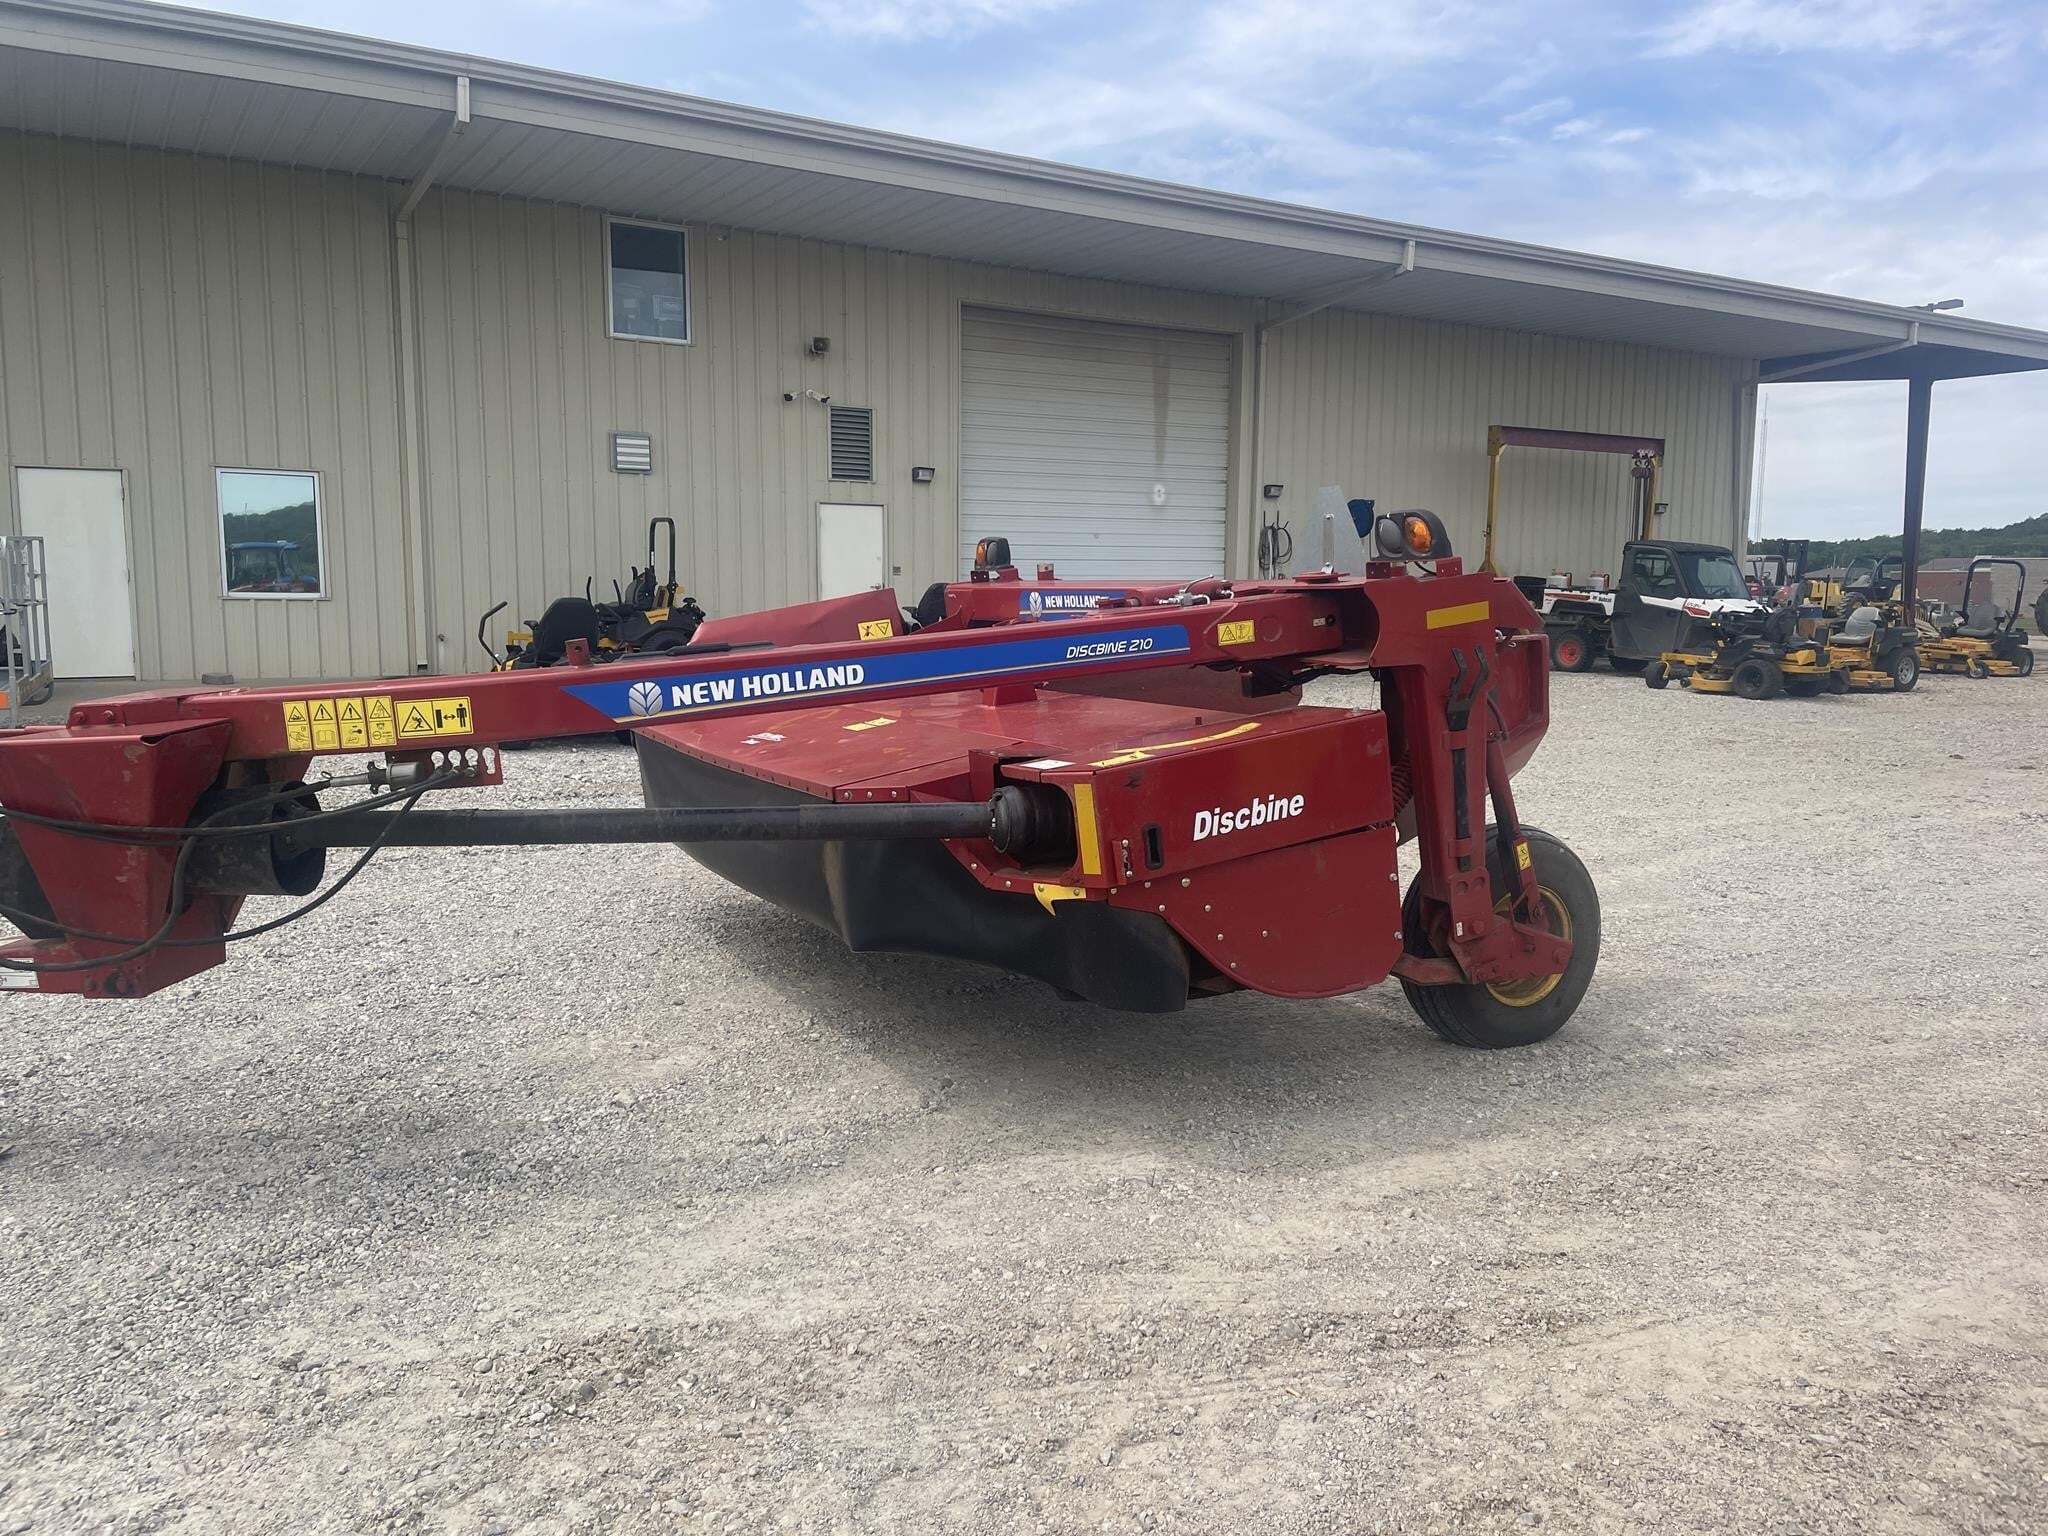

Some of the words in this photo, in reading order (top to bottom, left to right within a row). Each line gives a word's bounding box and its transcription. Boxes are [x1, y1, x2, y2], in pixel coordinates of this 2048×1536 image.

[1044, 595, 1063, 608] NEW
[1066, 640, 1127, 659] DISCBINE
[1129, 638, 1153, 652] 210
[671, 678, 735, 707] NEW
[743, 664, 865, 698] HOLLAND
[1193, 793, 1305, 841] Discbine
